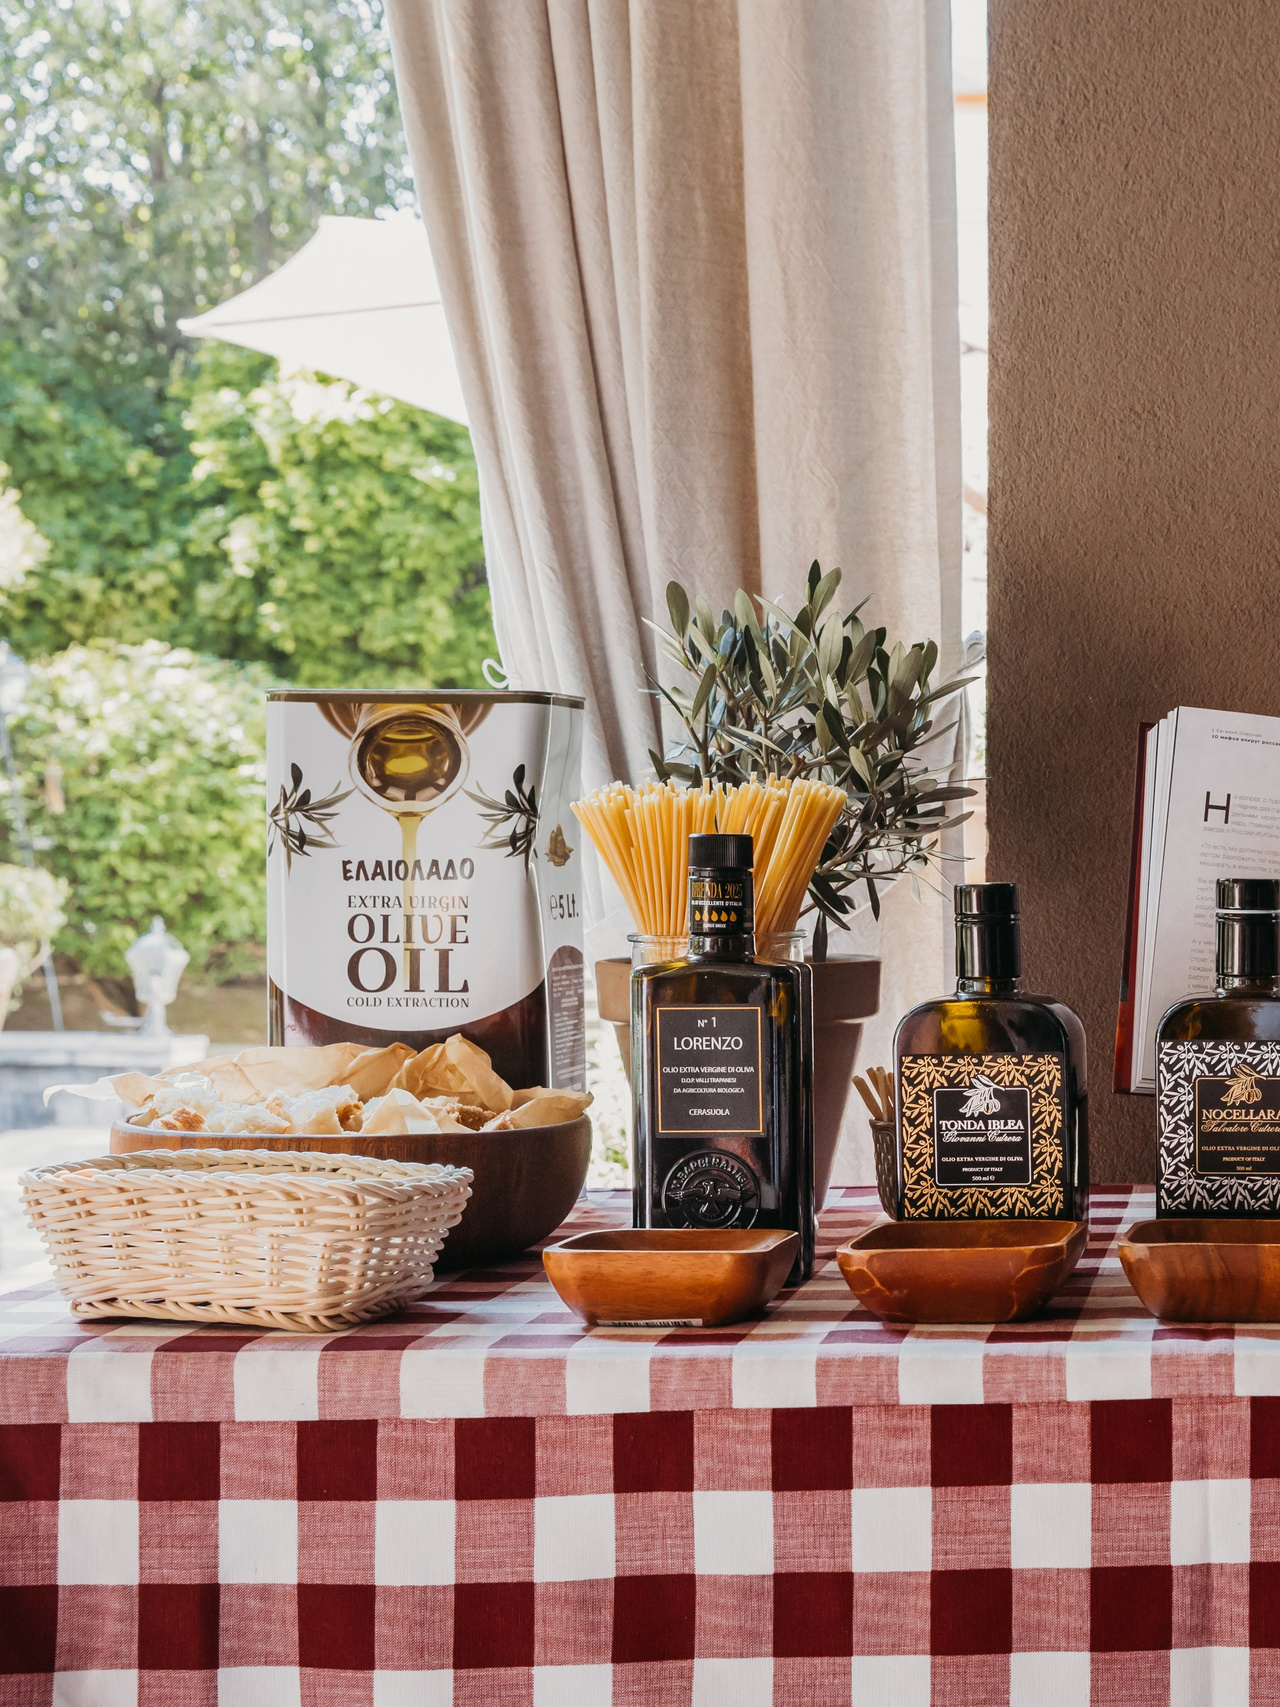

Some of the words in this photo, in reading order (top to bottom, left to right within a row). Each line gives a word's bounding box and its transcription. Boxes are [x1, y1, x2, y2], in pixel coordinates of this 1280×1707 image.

[342, 858, 474, 881] ΕΛΑΙΟΛΑΔΟ
[725, 883, 742, 898] 2025
[348, 896, 402, 908] EXTRA
[410, 895, 469, 912] VIRGIN
[348, 914, 469, 944] OLIVE
[348, 947, 469, 993] OIL
[347, 997, 382, 1007] COLD
[387, 998, 470, 1008] EXTRACTION
[711, 1017, 716, 1027] 1
[674, 1036, 743, 1050] LORENZO
[939, 1120, 986, 1130] TONDA
[988, 1120, 1024, 1130] IBLEA
[1201, 1120, 1249, 1132] Salvatore
[942, 1130, 986, 1142] Giovanni
[987, 1130, 1022, 1142] Cutrera
